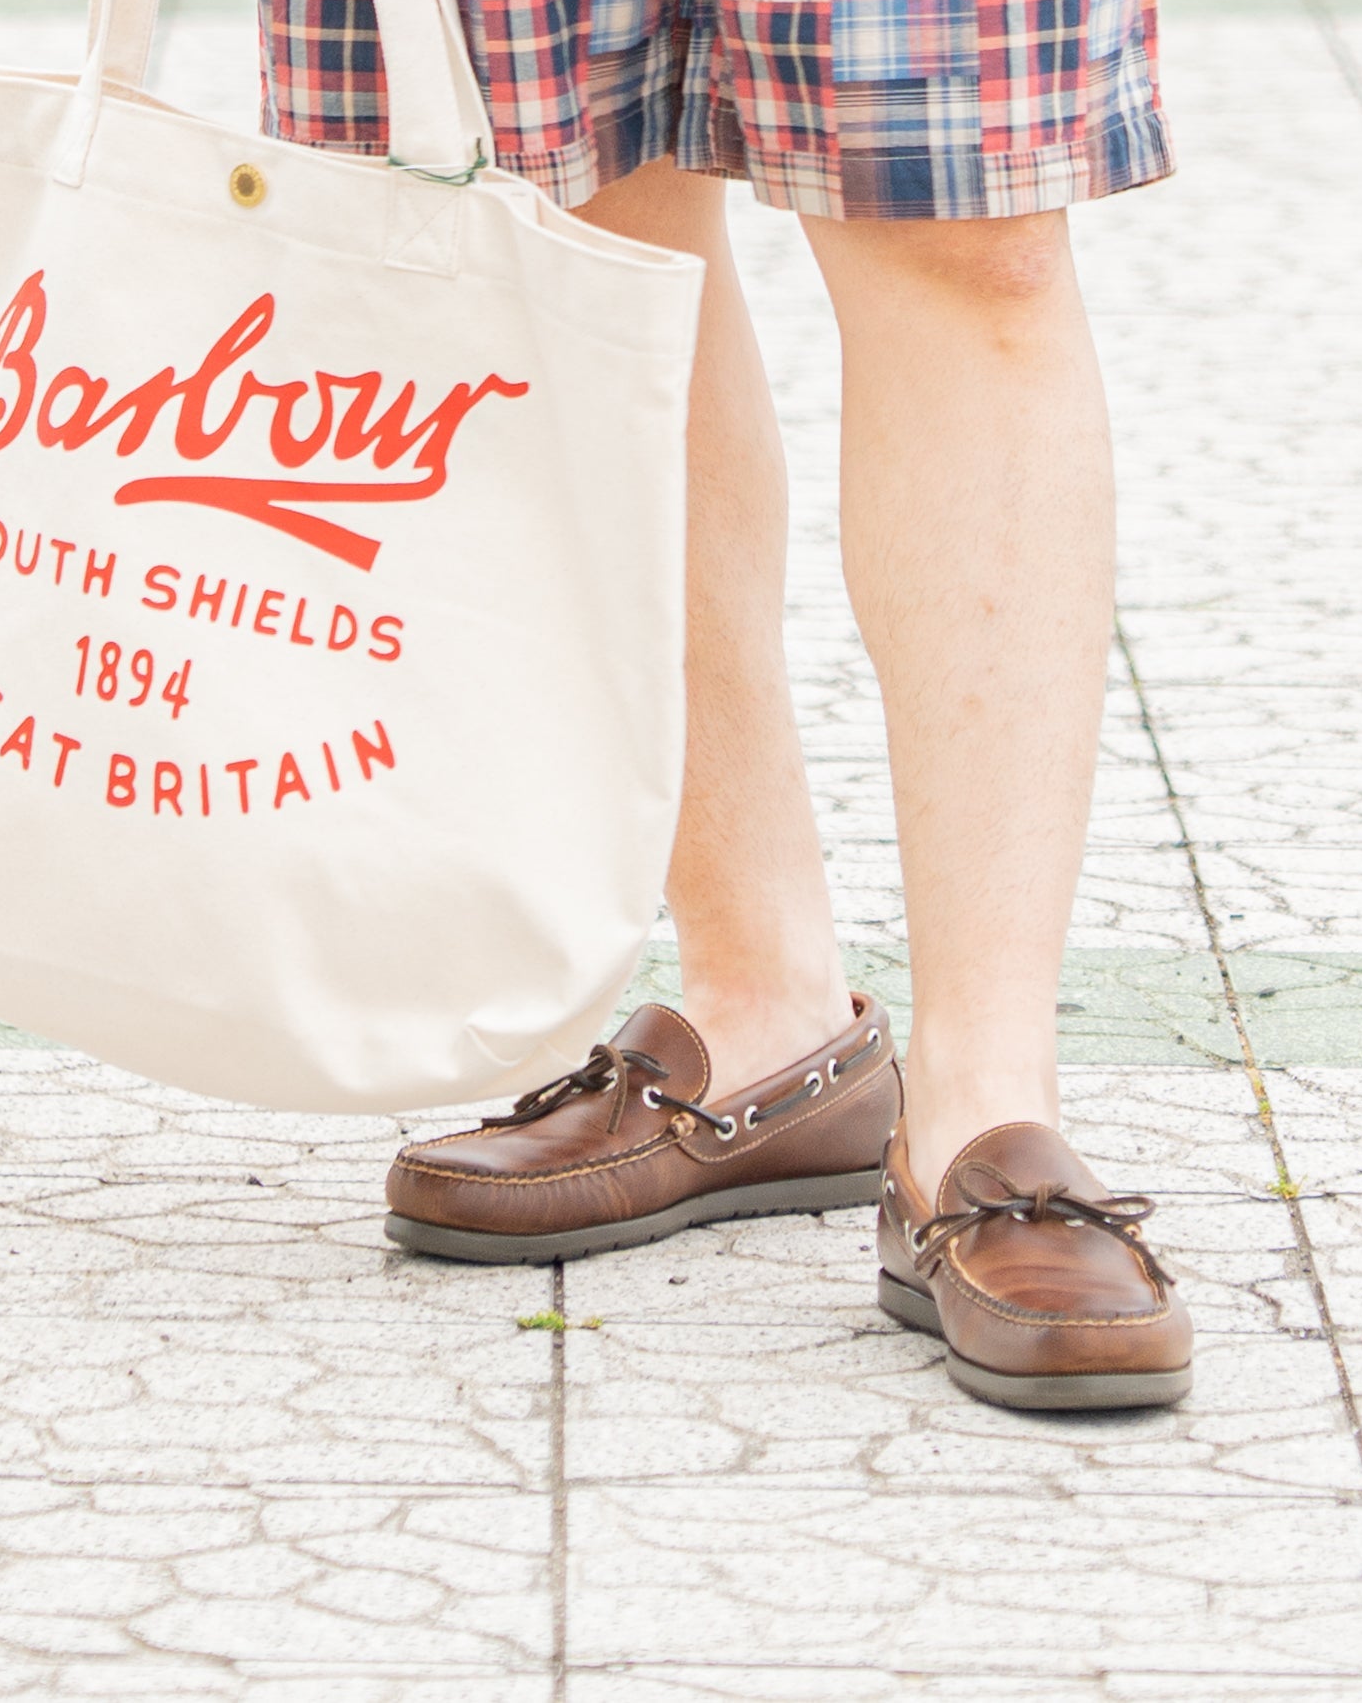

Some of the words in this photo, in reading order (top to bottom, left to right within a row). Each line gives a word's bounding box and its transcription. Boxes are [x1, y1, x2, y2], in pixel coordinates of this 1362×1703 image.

[140, 563, 405, 663] SHIELDS
[74, 634, 193, 721] 1894
[104, 718, 397, 818] BRITAIN
